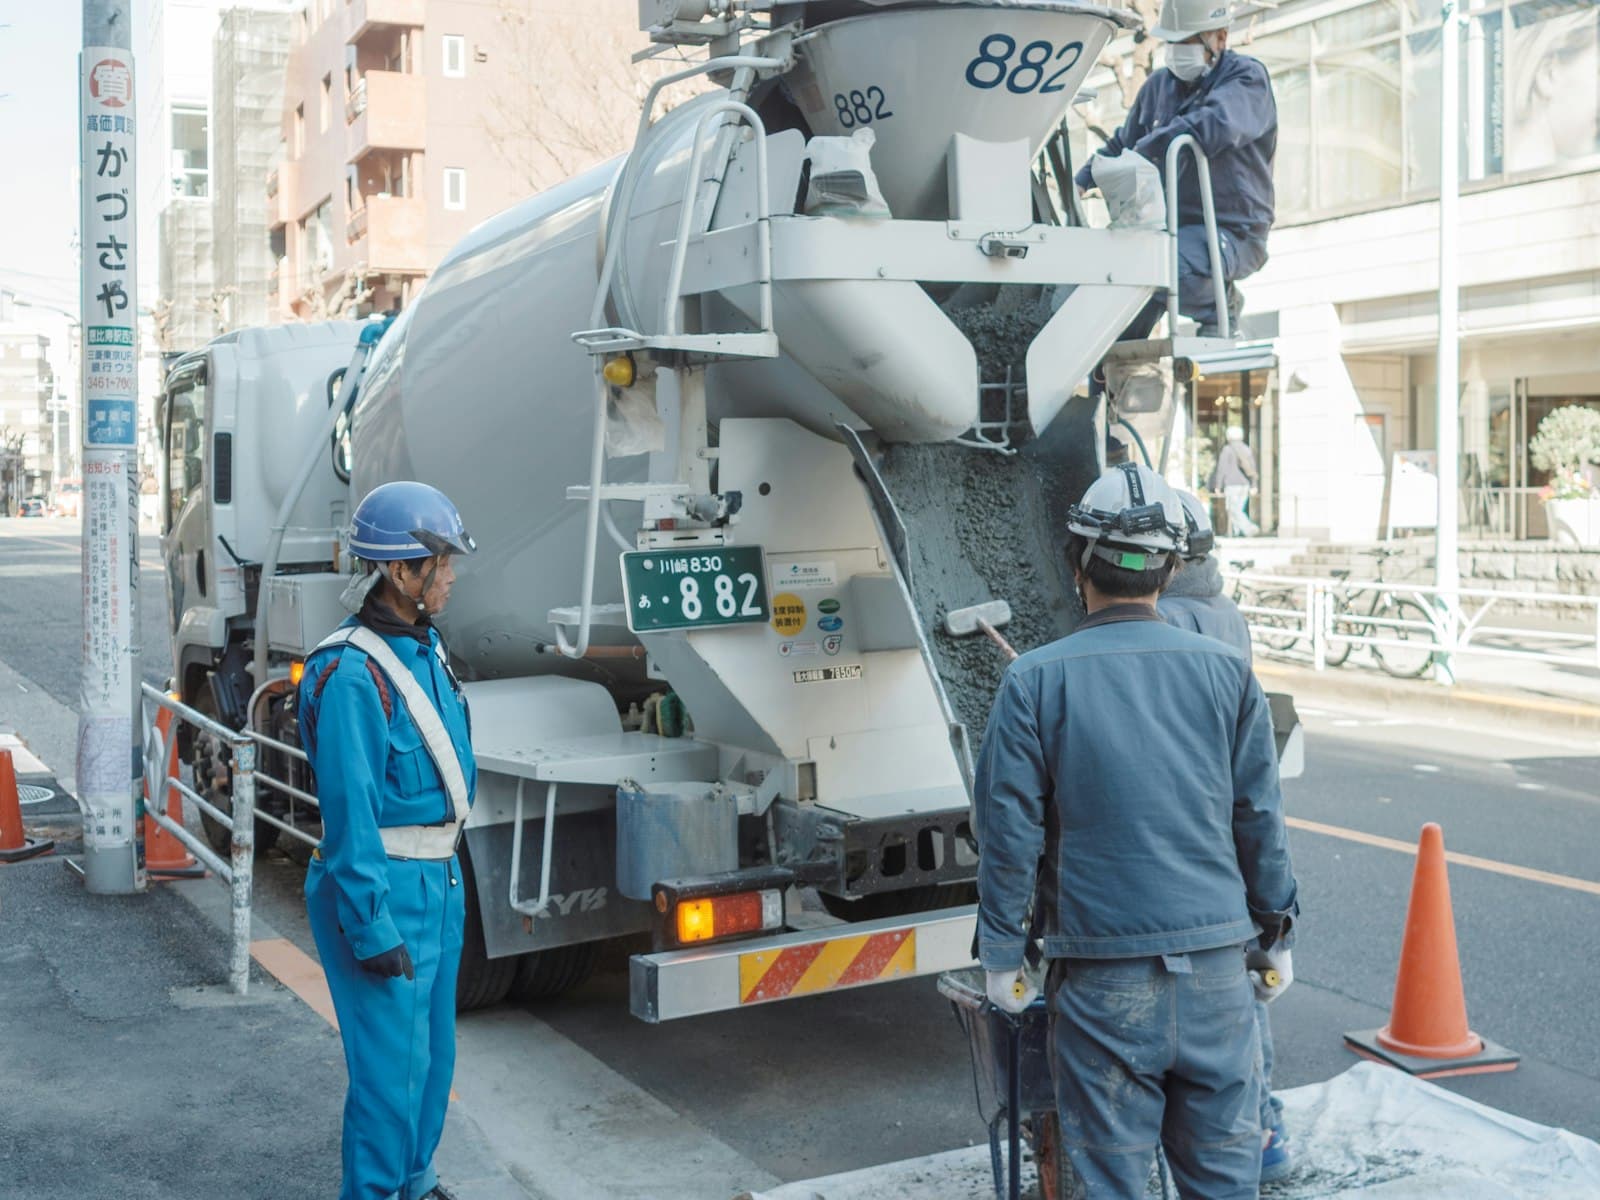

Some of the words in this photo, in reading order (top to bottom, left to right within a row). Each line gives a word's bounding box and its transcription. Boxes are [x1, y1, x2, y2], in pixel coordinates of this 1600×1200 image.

[965, 33, 1084, 95] 882
[834, 85, 894, 129] 882
[96, 140, 129, 318] かづさや
[87, 349, 135, 361] 三菱東京UF
[638, 593, 651, 609] あ
